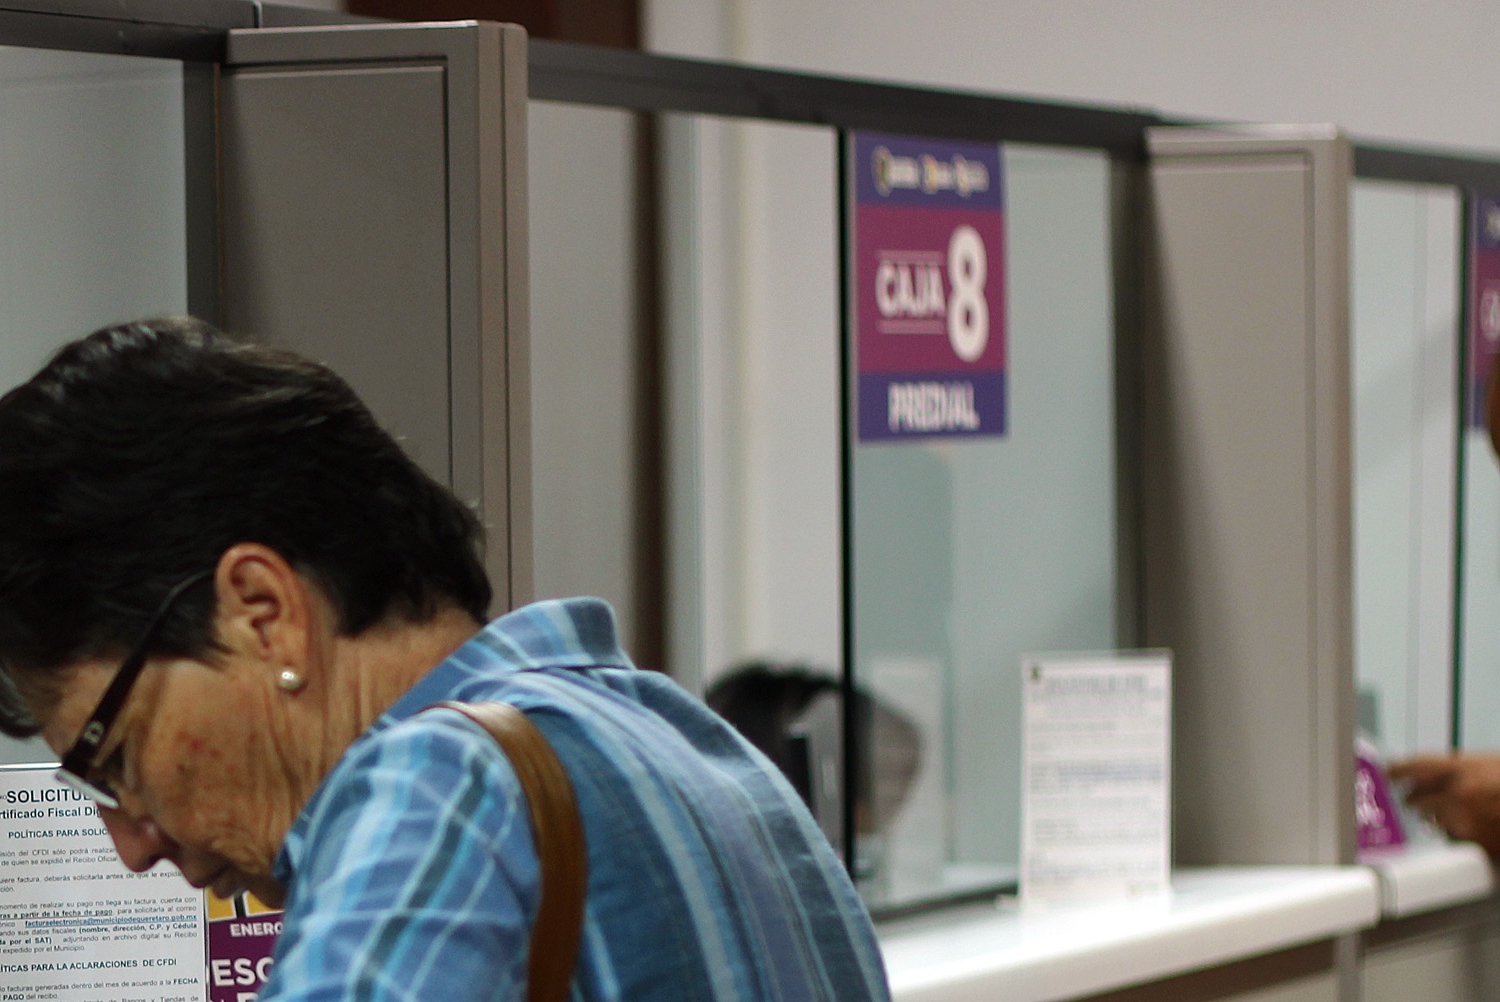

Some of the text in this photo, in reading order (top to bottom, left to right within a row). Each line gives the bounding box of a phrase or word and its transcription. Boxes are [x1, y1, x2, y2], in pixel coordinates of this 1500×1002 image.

[875, 224, 990, 363] CAJA 8
[888, 381, 980, 432] PREDIAL
[48, 806, 80, 817] Fiscal
[8, 829, 53, 839] POLÍTICAS
[70, 846, 88, 856] podrá
[11, 858, 29, 866] quien
[41, 856, 63, 865] expidió
[106, 898, 121, 907] llega
[21, 910, 39, 919] partir
[230, 922, 284, 937] ENERO
[141, 931, 159, 941] digital
[3, 946, 32, 955] expedido
[70, 960, 137, 970] ACLARACIONES
[206, 957, 274, 986] ESC
